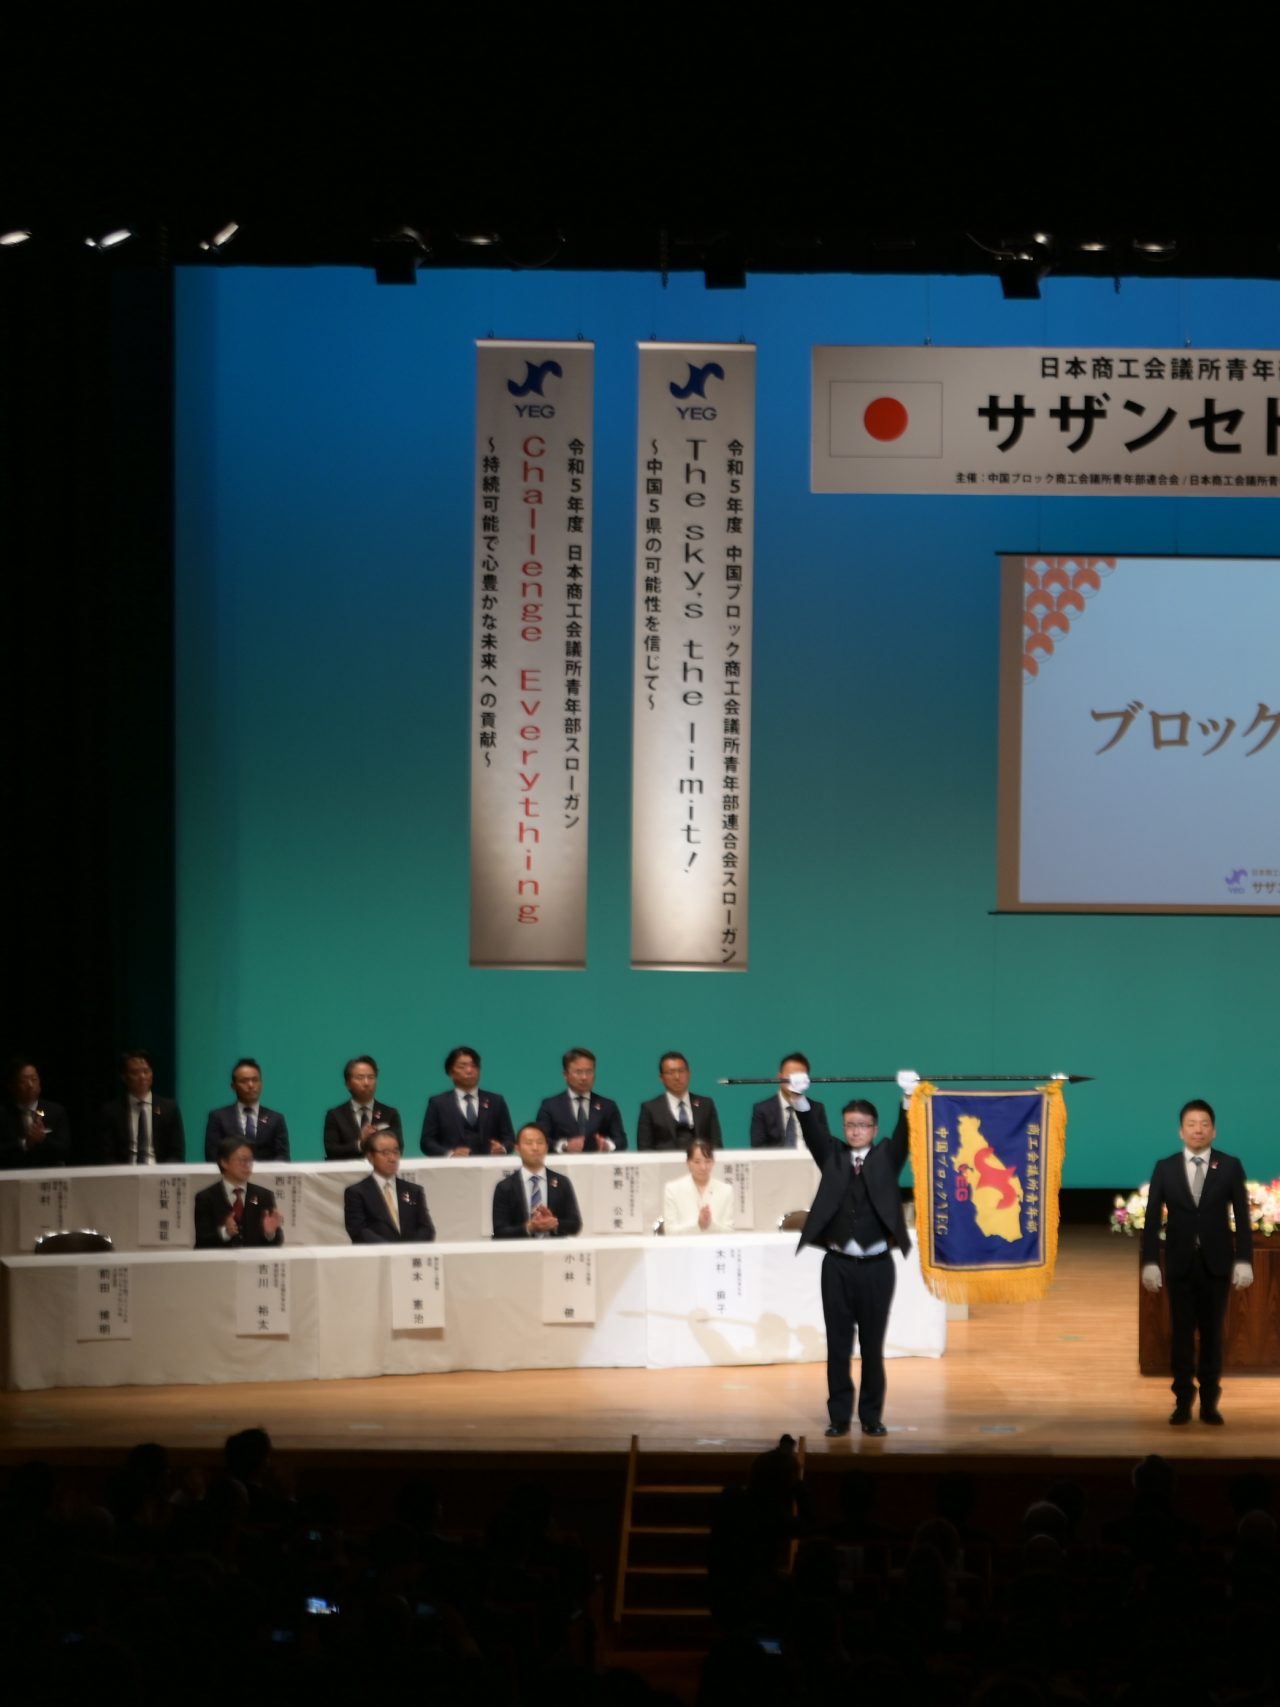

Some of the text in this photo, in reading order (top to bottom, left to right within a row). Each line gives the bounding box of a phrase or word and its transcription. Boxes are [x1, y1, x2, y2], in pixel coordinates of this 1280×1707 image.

[515, 404, 556, 419] YEG
[677, 407, 718, 421] YEG
[684, 439, 707, 507] The
[726, 439, 744, 534] 令和5年度
[563, 438, 585, 829] 令和5年度 日本商工会議所青年部スローガン
[517, 435, 546, 924] Challenge Everything
[682, 640, 704, 706] the
